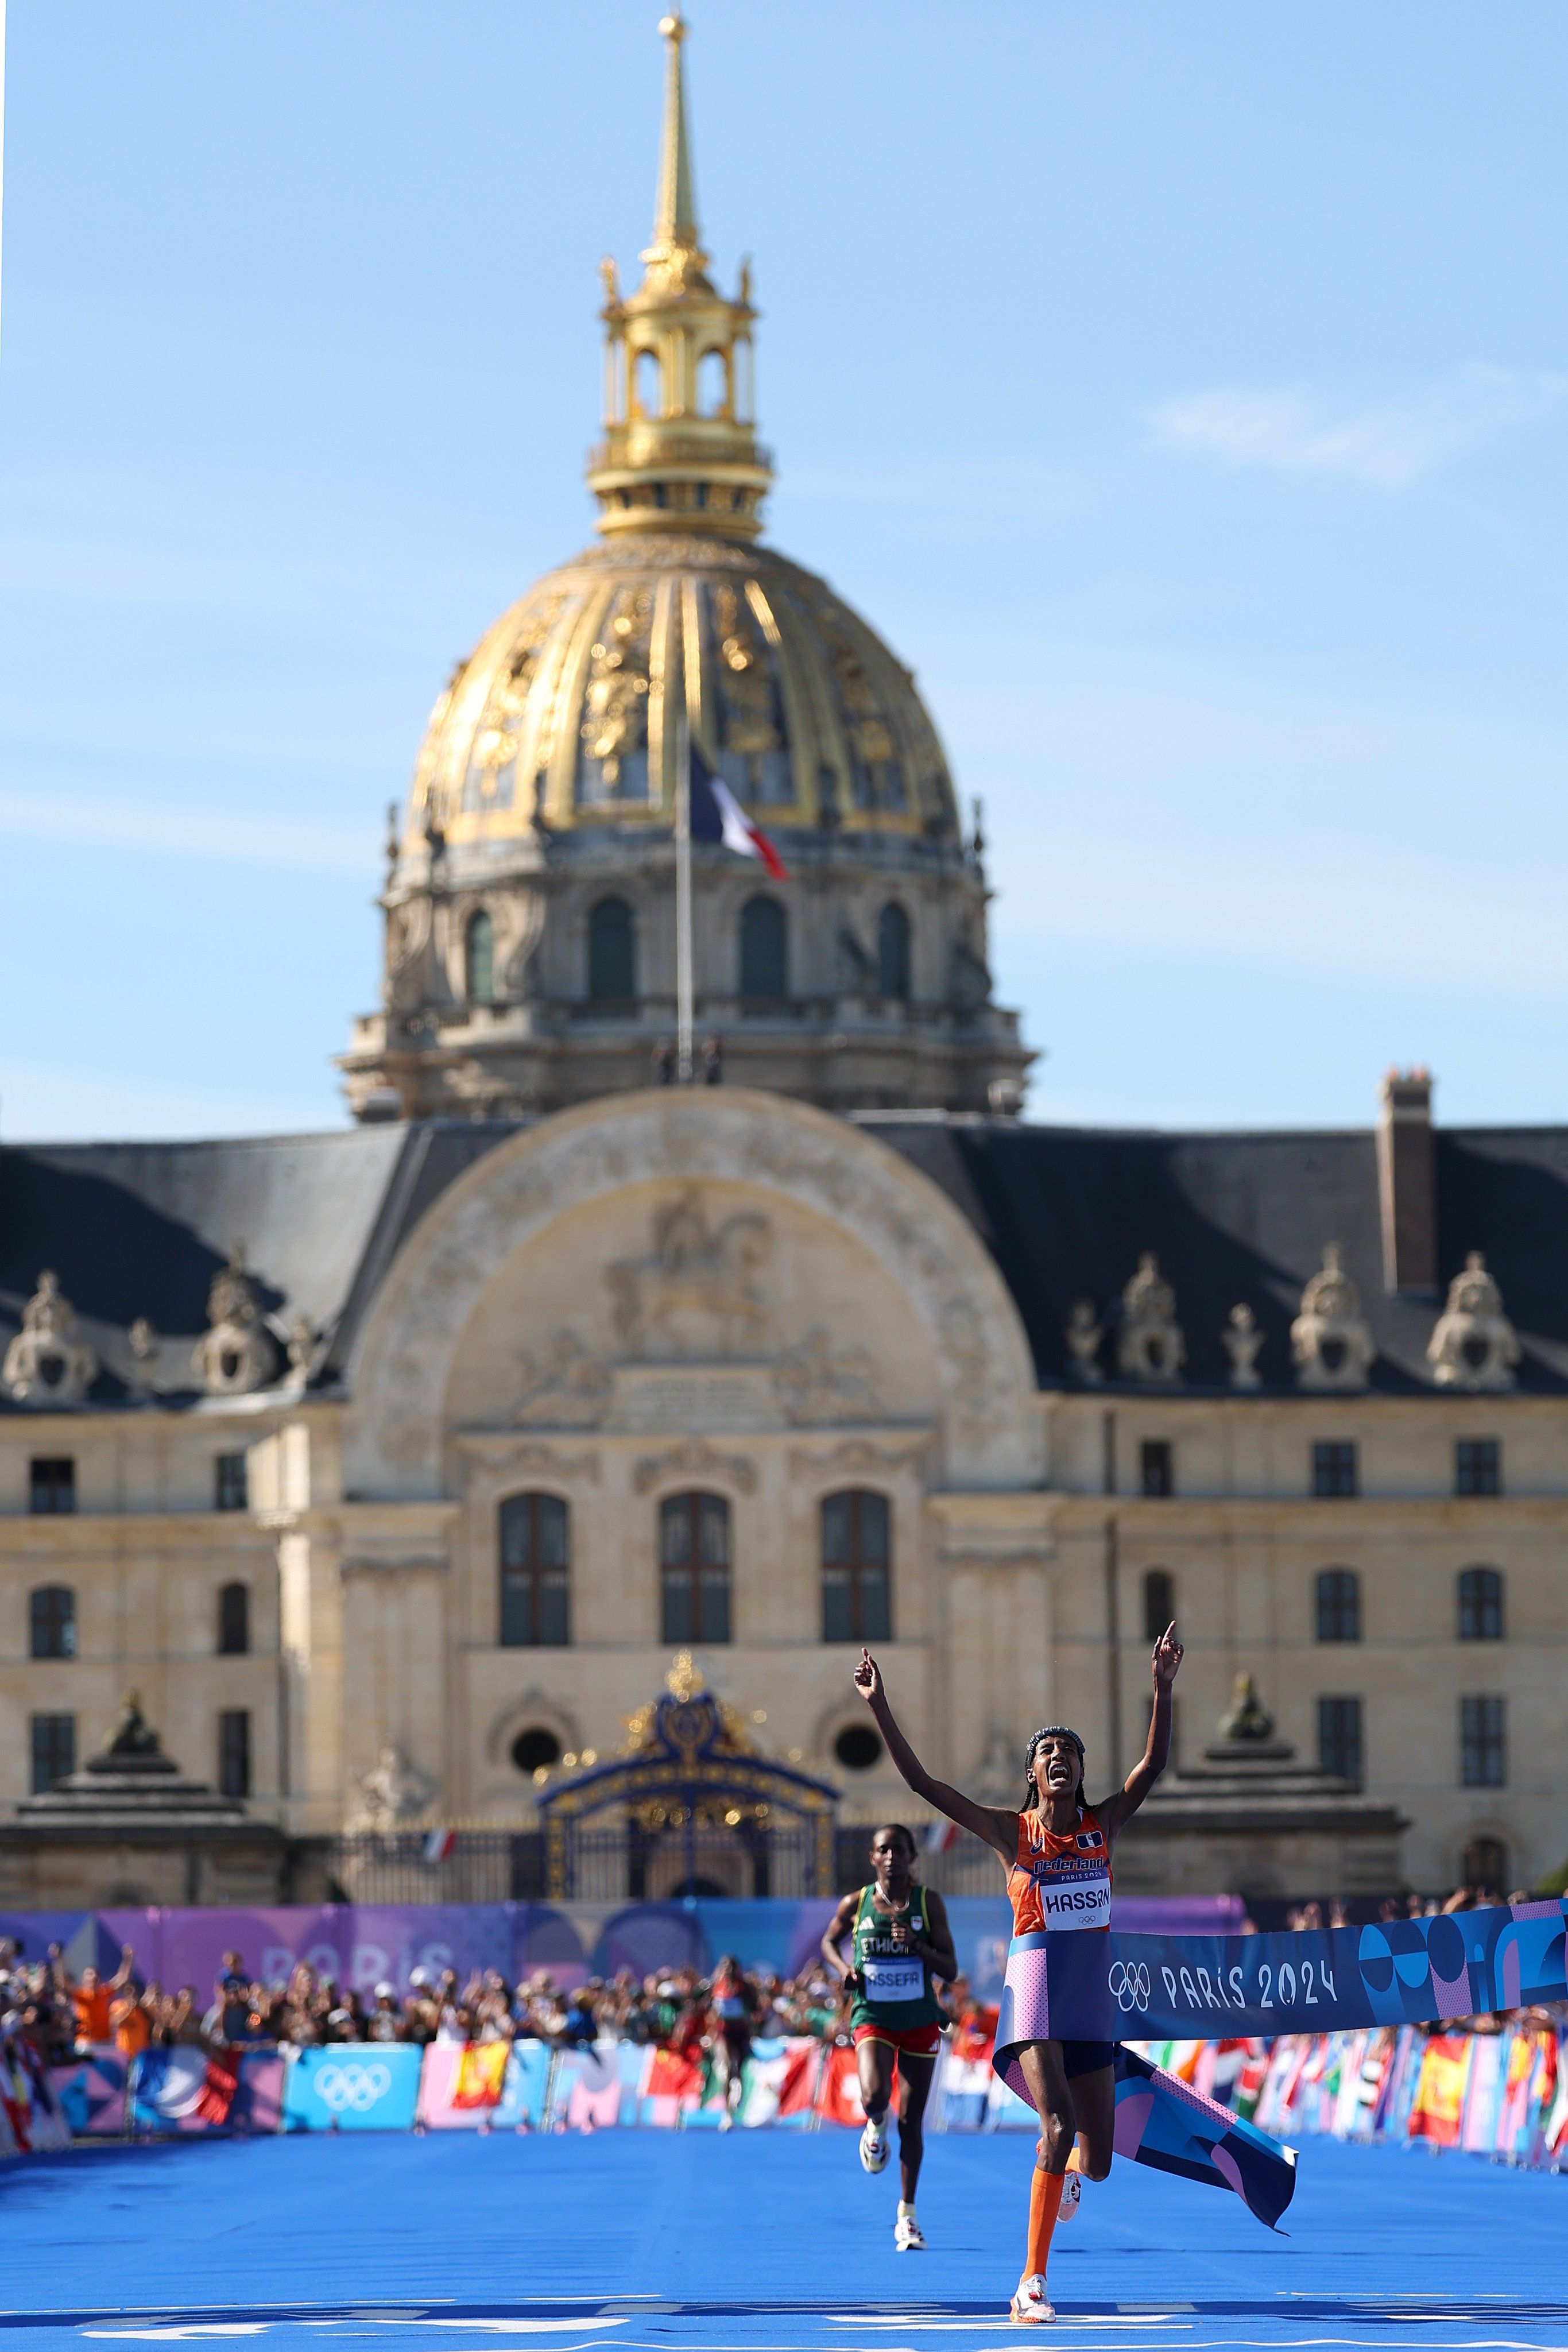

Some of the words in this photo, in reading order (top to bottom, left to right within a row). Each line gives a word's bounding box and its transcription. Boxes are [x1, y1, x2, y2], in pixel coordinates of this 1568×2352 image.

[1034, 1855, 1104, 1874] nederland
[1045, 1887, 1110, 1913] HASSAN
[861, 1937, 909, 1954] ETHIO
[868, 1971, 919, 1986] ASSEFA
[1161, 1966, 1246, 2009] PARIS
[1258, 1960, 1338, 2008] 2024
